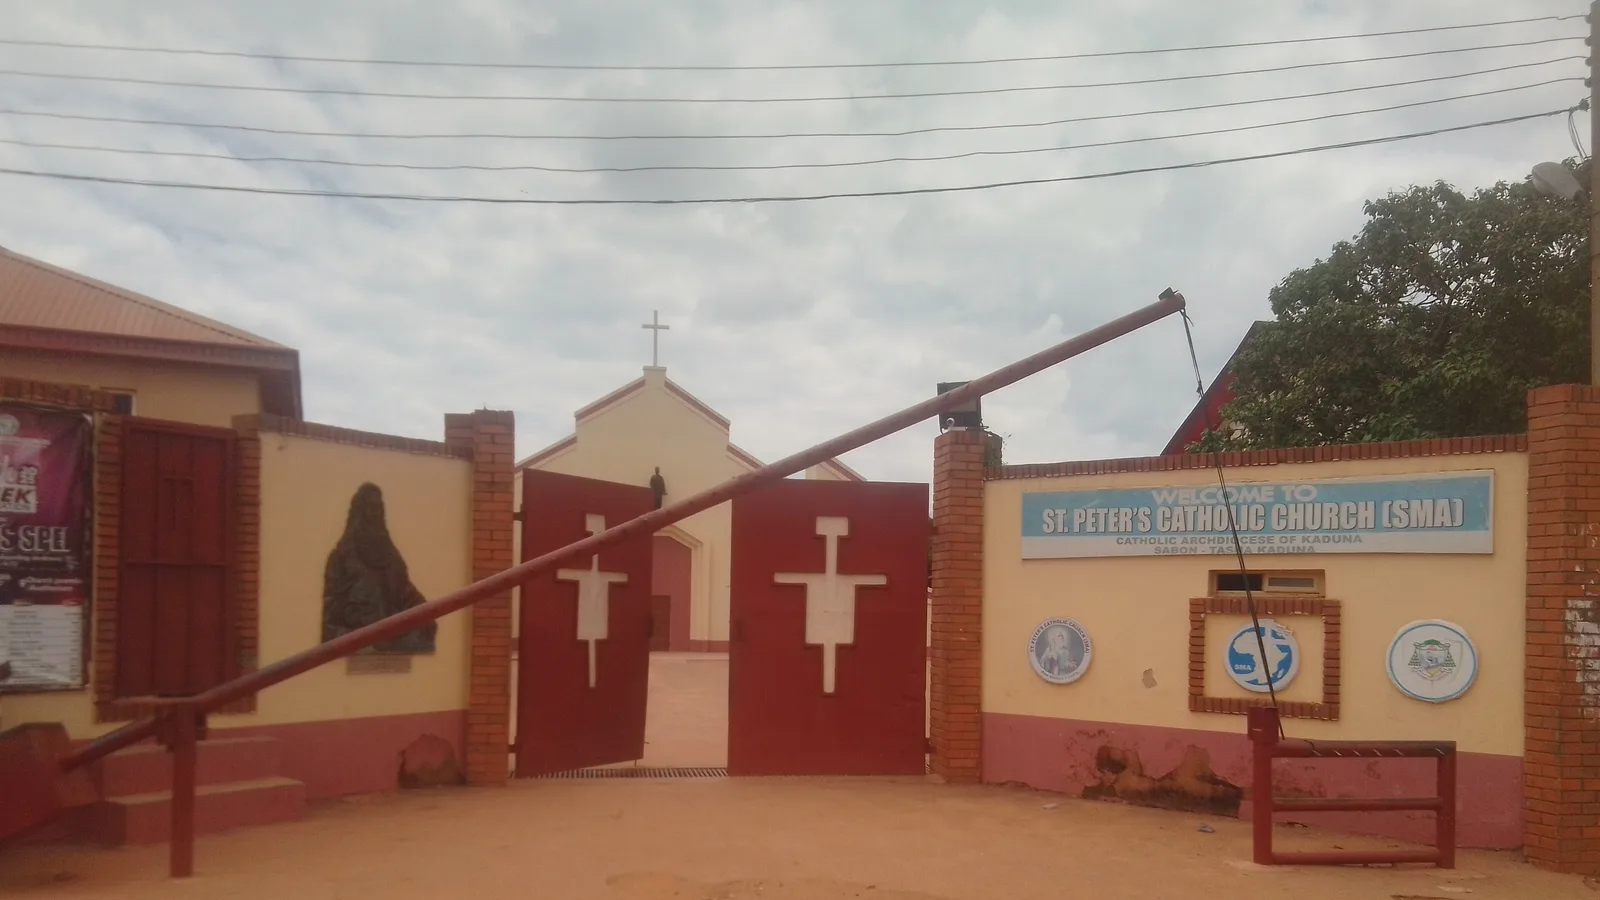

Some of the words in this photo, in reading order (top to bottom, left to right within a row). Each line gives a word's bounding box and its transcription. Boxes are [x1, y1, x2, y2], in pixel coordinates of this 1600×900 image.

[1151, 486, 1274, 505] WELCOME
[1281, 484, 1318, 503] TO
[1042, 508, 1069, 533] ST.
[1073, 506, 1152, 533] PETER'S
[1156, 503, 1266, 532] CATHOLIC
[1271, 500, 1376, 531] CHURCH
[1382, 498, 1464, 529] (SMA)
[1116, 536, 1177, 545] CATHOLIC
[1279, 535, 1296, 544] OF
[1301, 534, 1363, 544] KADUNA
[1154, 546, 1198, 554] SABON
[1257, 545, 1316, 554] KADUNA
